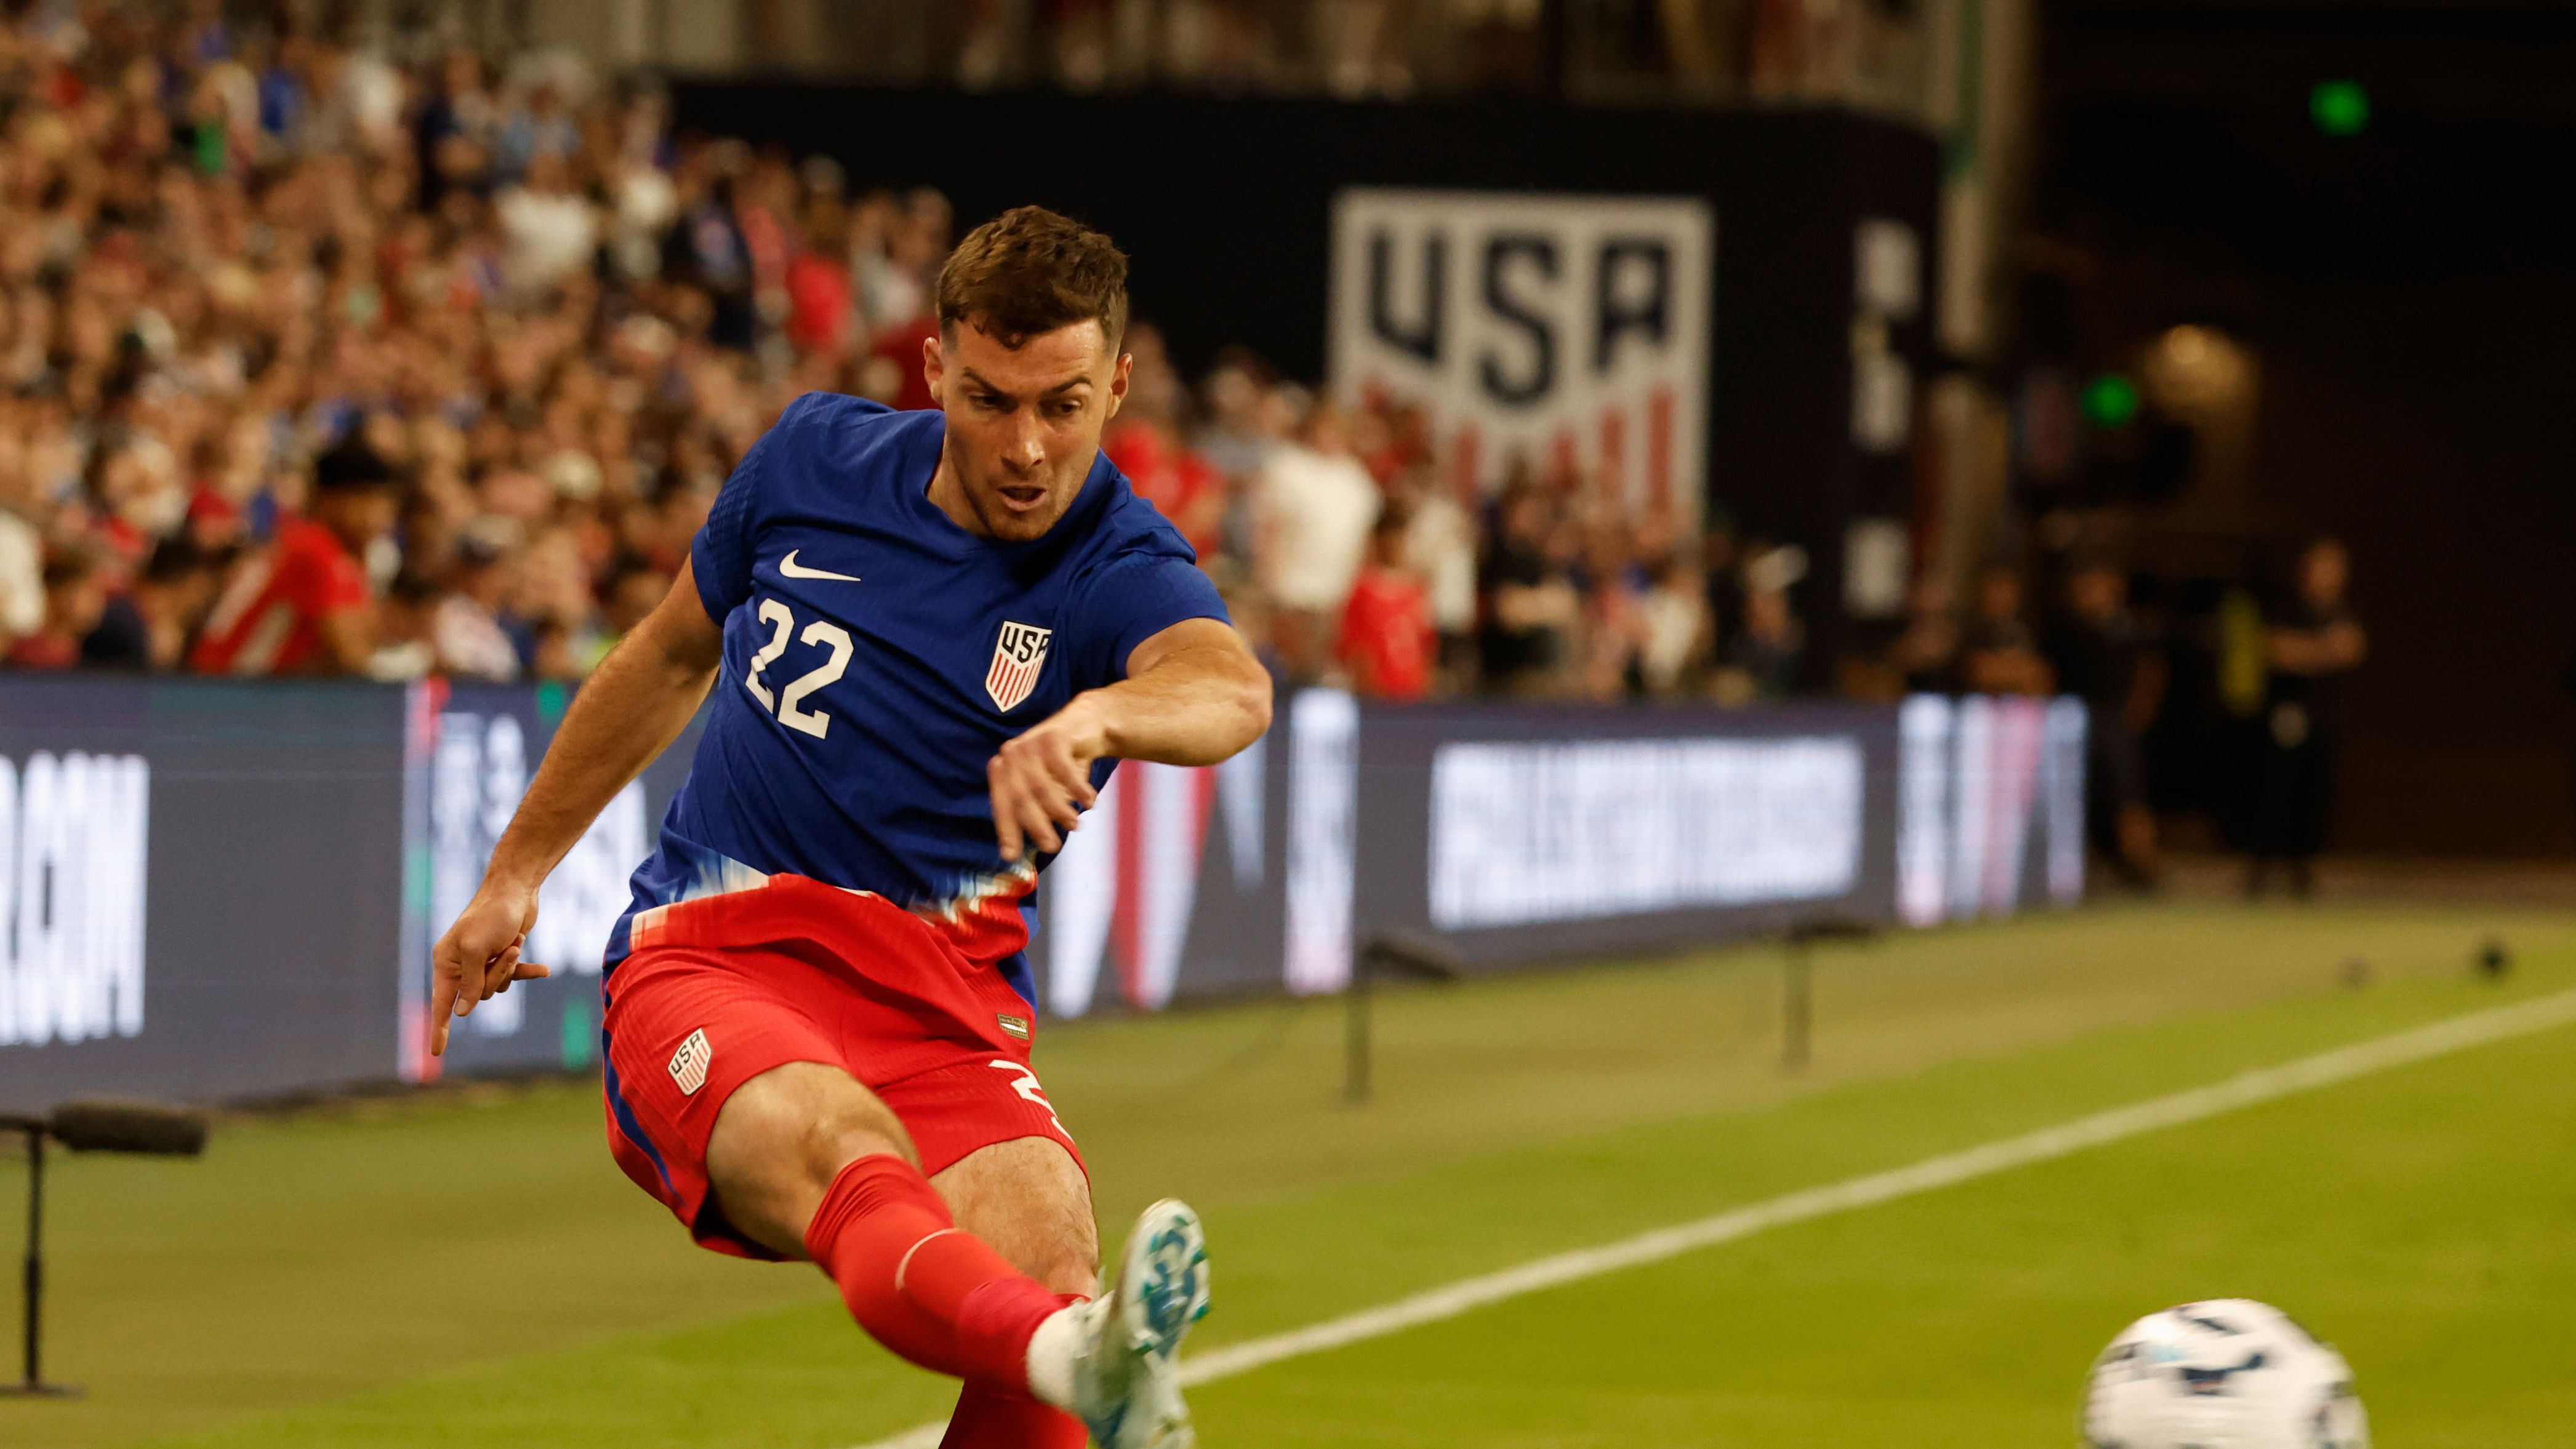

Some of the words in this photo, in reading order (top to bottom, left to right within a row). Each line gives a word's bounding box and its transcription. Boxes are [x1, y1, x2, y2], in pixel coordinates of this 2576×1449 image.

[1366, 228, 1672, 411] USA
[745, 597, 854, 740] 22
[1001, 625, 1051, 664] USA
[671, 1033, 700, 1075] USA
